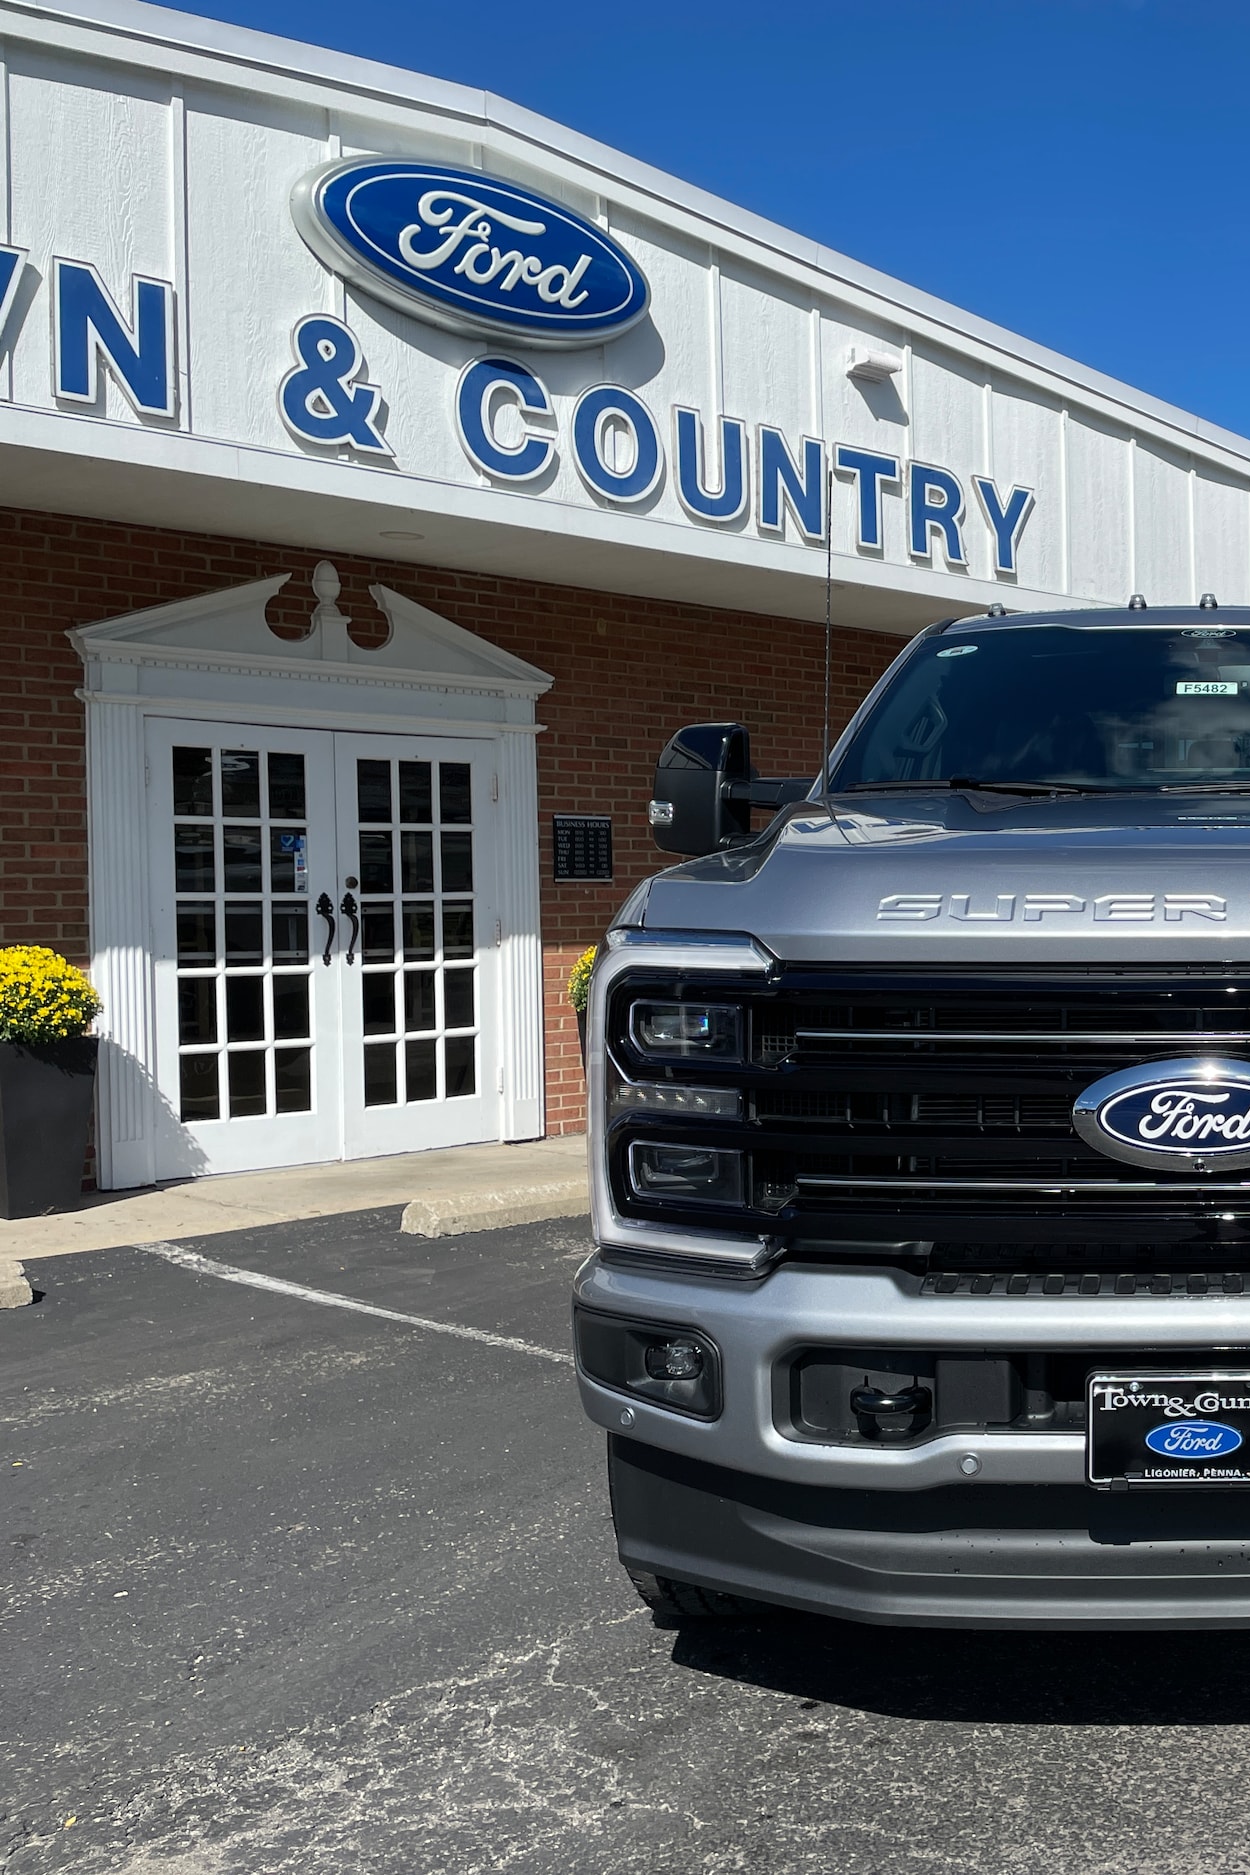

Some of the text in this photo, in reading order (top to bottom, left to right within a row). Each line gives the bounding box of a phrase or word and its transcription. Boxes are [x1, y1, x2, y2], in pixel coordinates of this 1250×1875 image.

[399, 190, 593, 310] Ford
[278, 312, 396, 458] &
[454, 353, 1035, 574] COUNTRY
[1183, 684, 1228, 693] F5482
[877, 894, 1227, 922] SUPER
[1094, 1388, 1168, 1411] Town
[1163, 1396, 1197, 1417] &
[1164, 1426, 1223, 1451] Ford
[1144, 1467, 1245, 1478] LIGONIER, PENNA.
